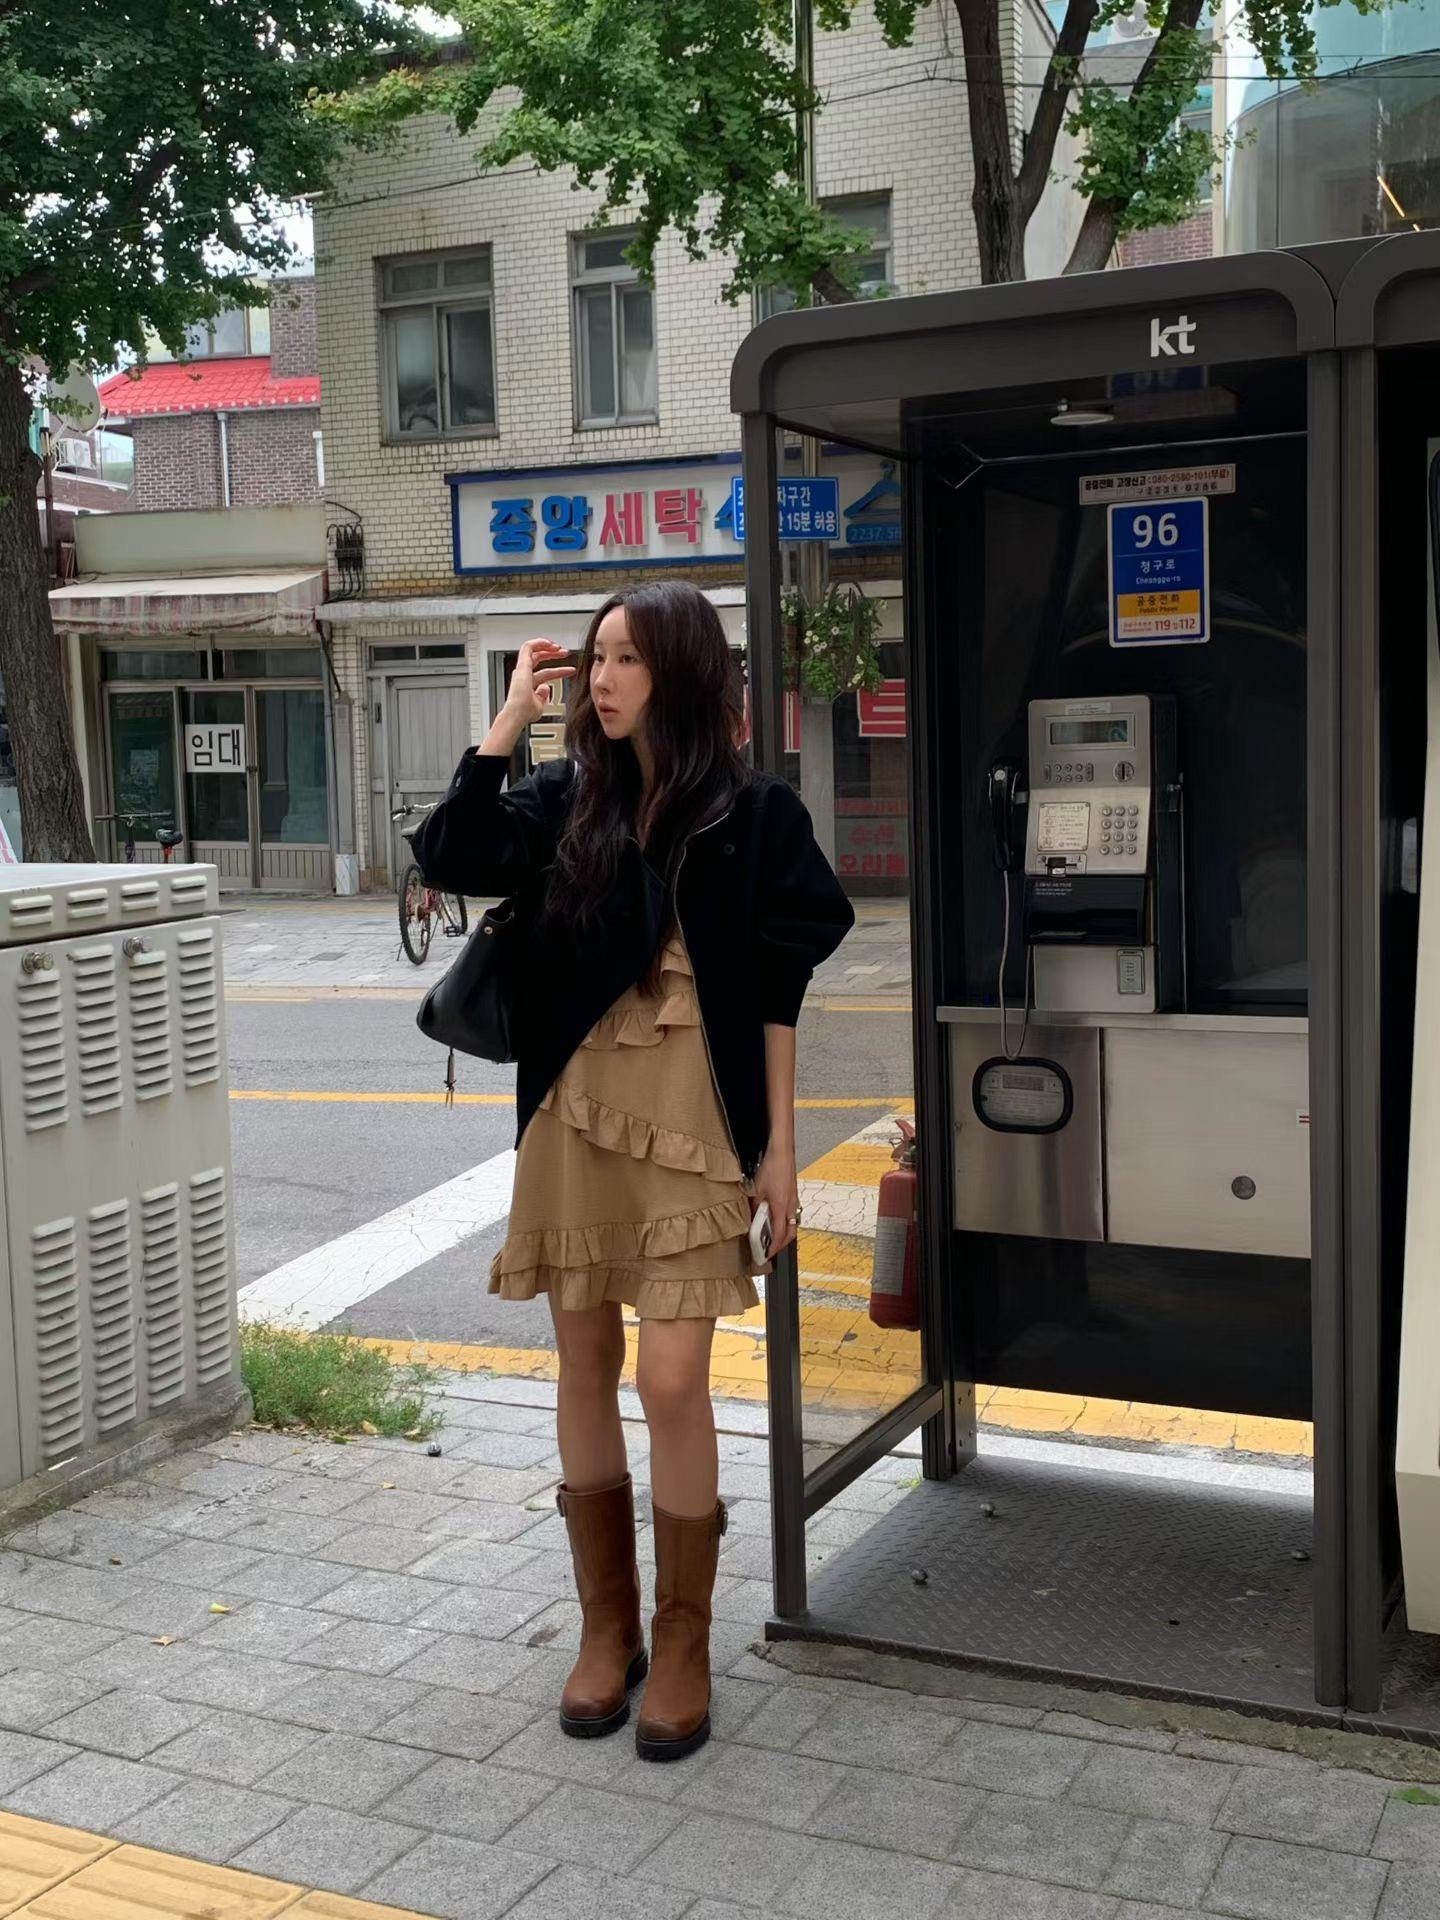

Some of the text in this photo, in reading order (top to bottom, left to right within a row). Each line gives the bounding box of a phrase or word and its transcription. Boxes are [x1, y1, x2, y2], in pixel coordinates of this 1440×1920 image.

[1150, 315, 1197, 357] kt
[787, 511, 811, 532] 15분
[814, 510, 836, 532] 허용
[1132, 512, 1179, 548] 96
[1140, 559, 1176, 574] 청구로
[1137, 594, 1180, 607] 공중전화
[1155, 619, 1171, 631] 119
[1180, 618, 1196, 630] 112
[191, 728, 241, 766] 임대
